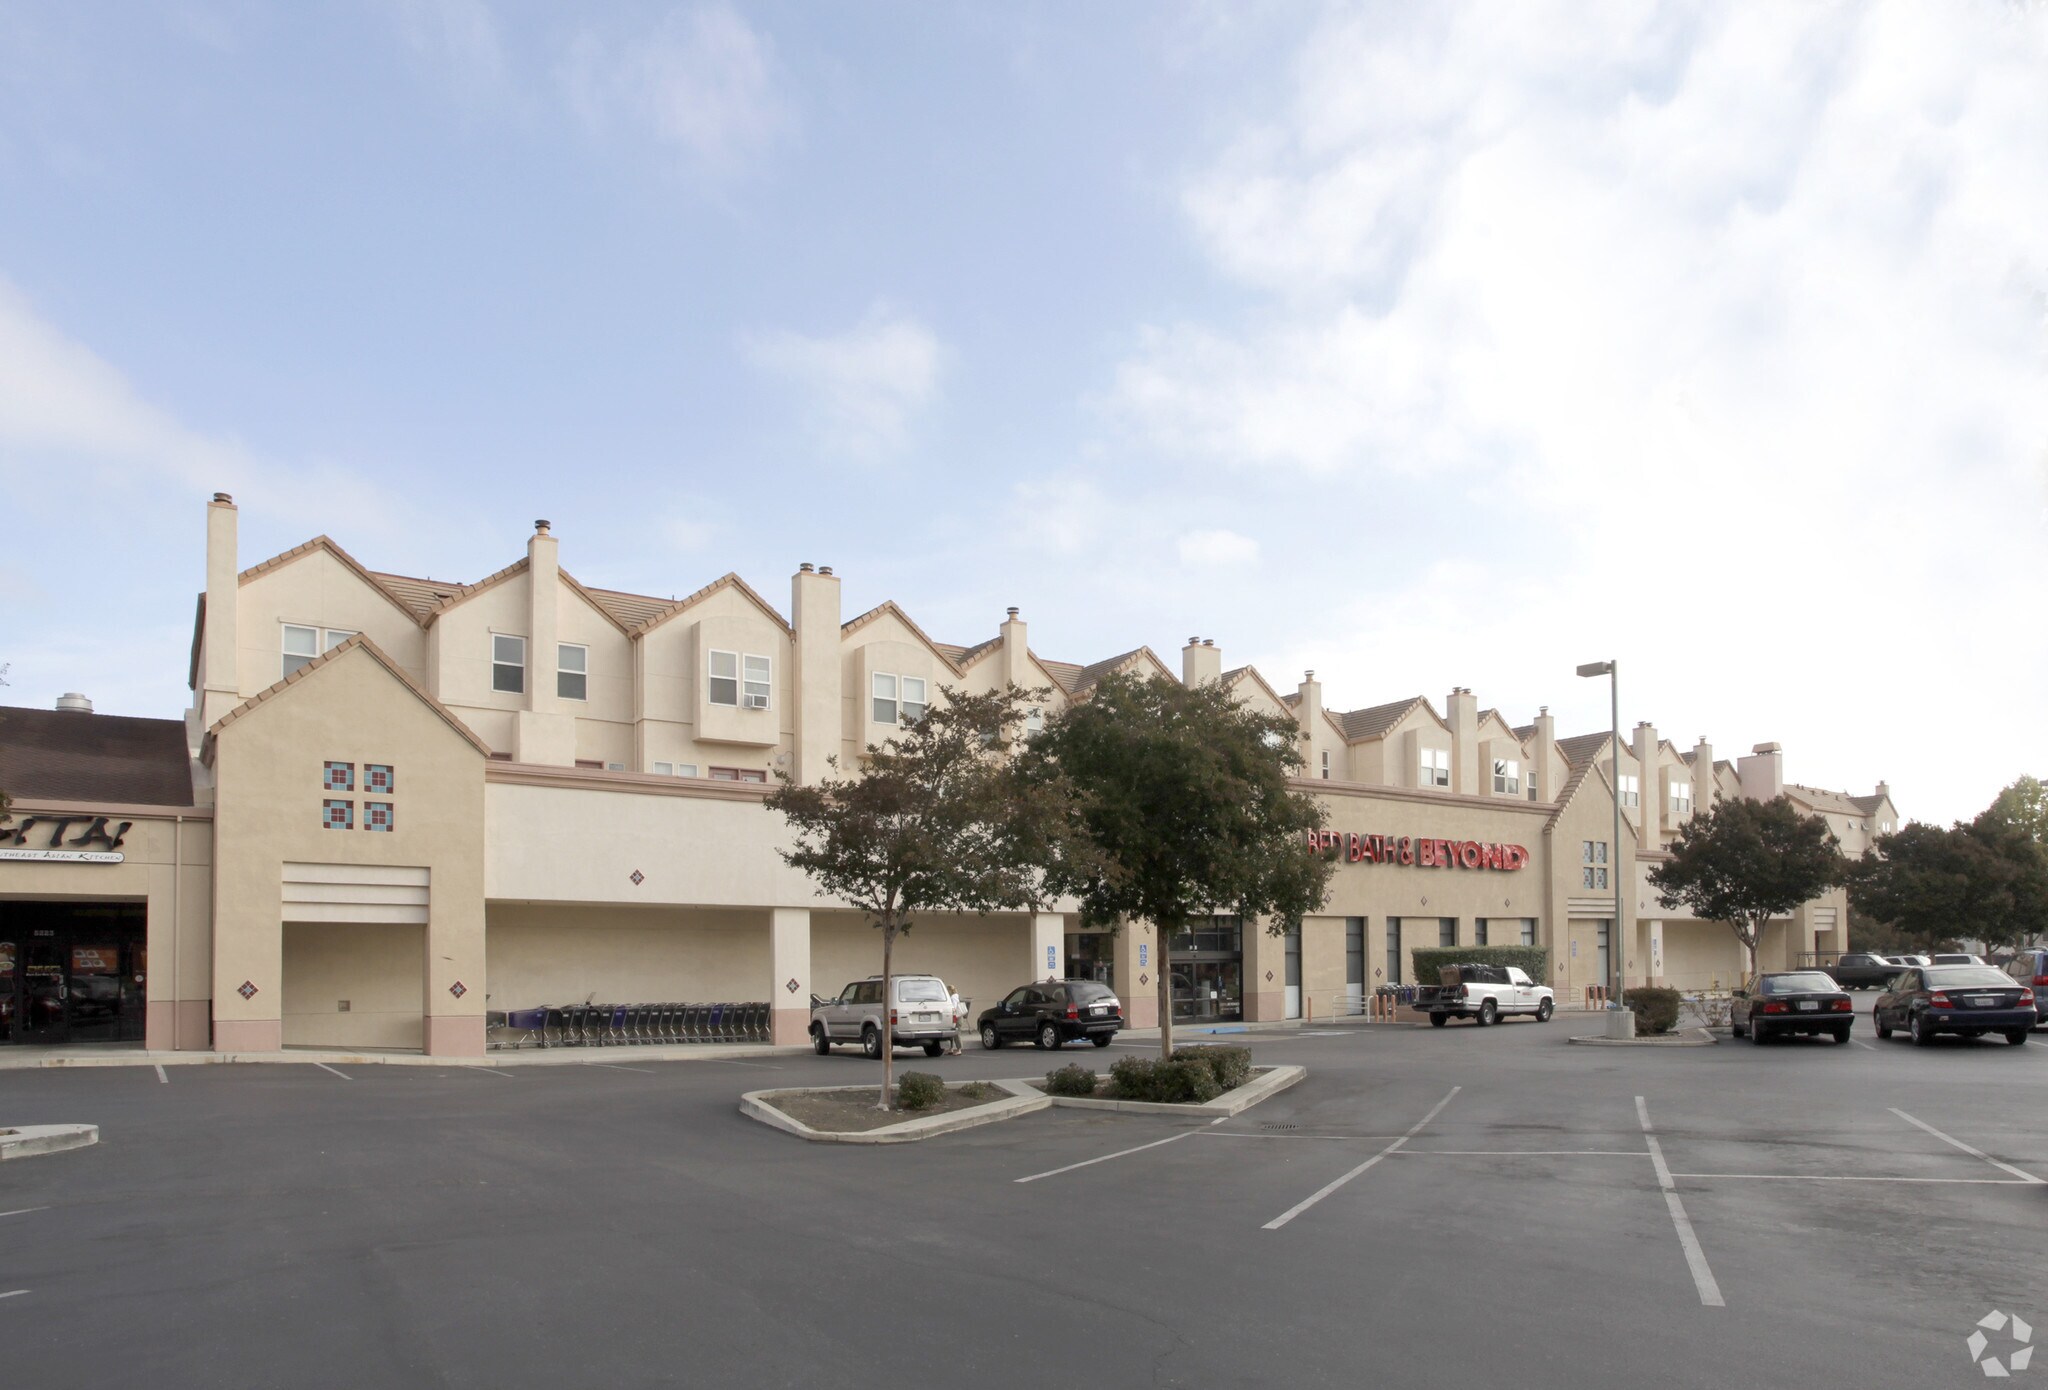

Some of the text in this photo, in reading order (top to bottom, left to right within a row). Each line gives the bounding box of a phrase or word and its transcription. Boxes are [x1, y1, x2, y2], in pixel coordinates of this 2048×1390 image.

[43, 851, 73, 859] ASIAN
[1346, 832, 1396, 864] BATH
[1398, 835, 1414, 865] &
[1416, 837, 1530, 870] BEYOND
